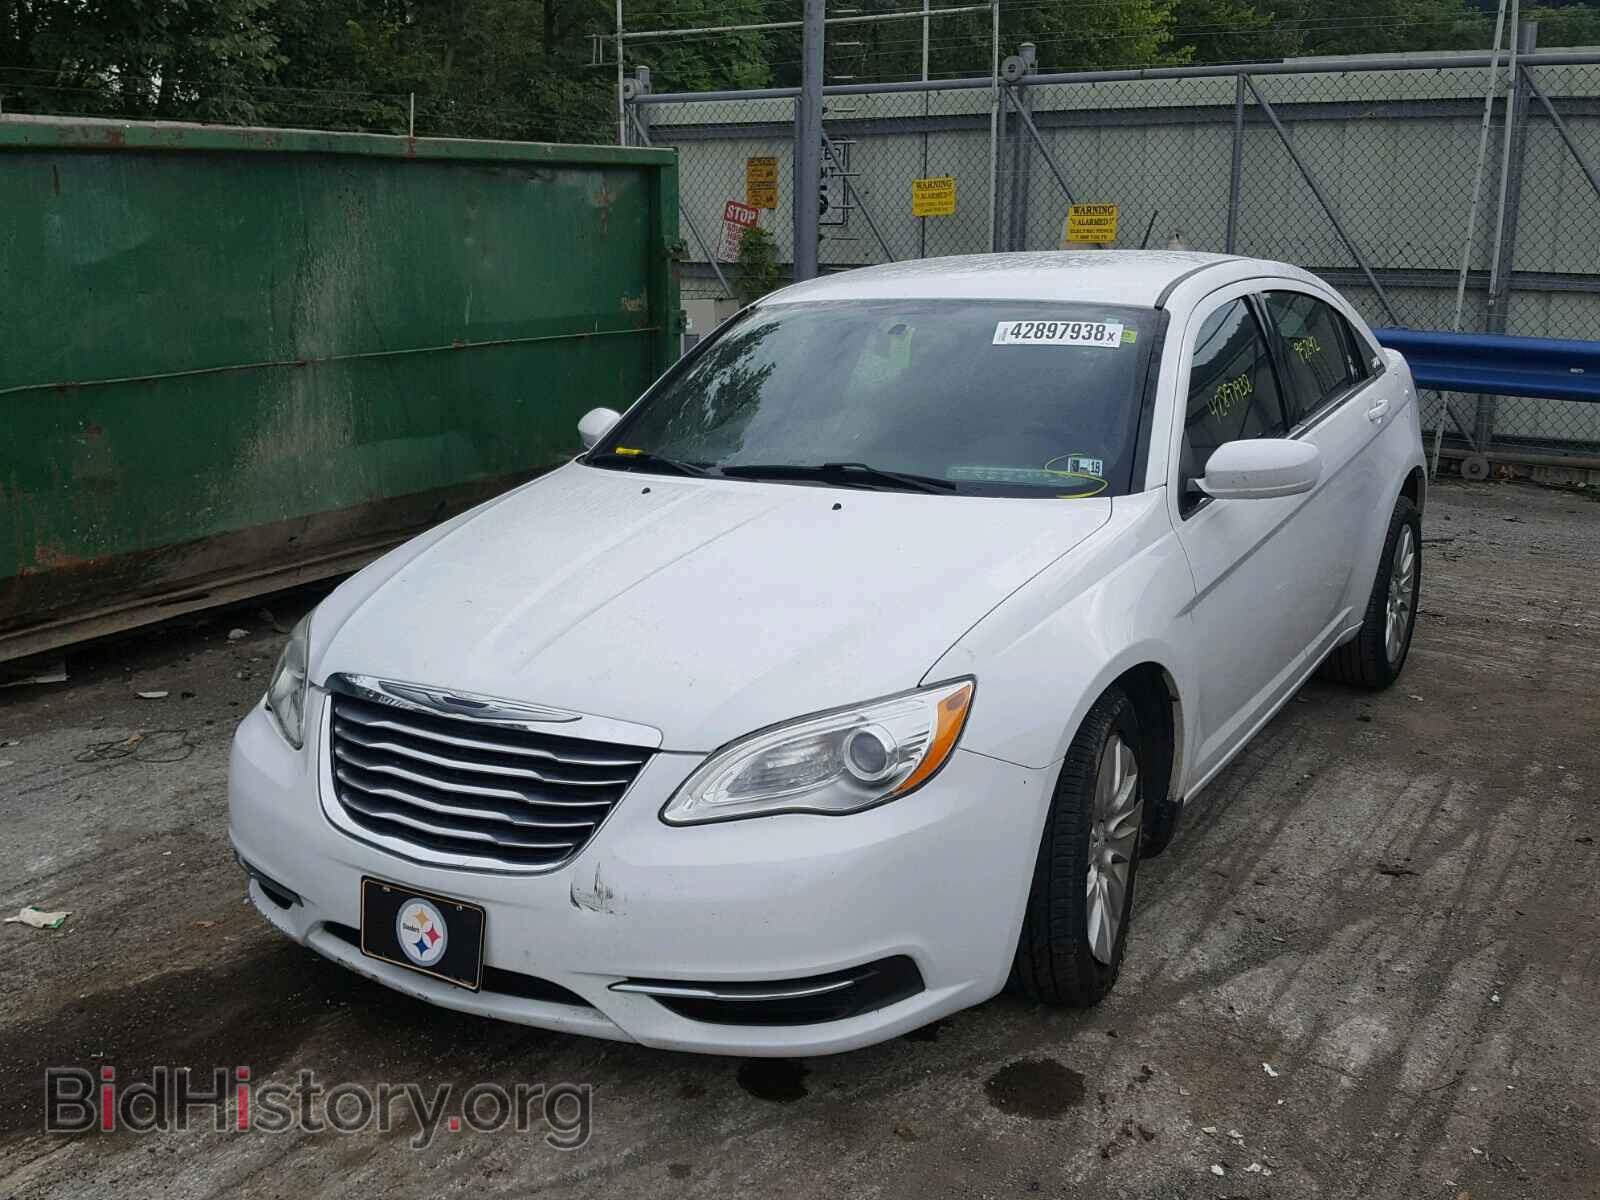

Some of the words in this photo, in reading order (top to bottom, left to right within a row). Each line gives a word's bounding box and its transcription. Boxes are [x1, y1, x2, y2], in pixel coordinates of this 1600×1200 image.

[916, 180, 953, 190] WARNING
[726, 204, 757, 224] STOP
[1073, 205, 1114, 215] WARNING
[1010, 322, 1106, 341] 42897938
